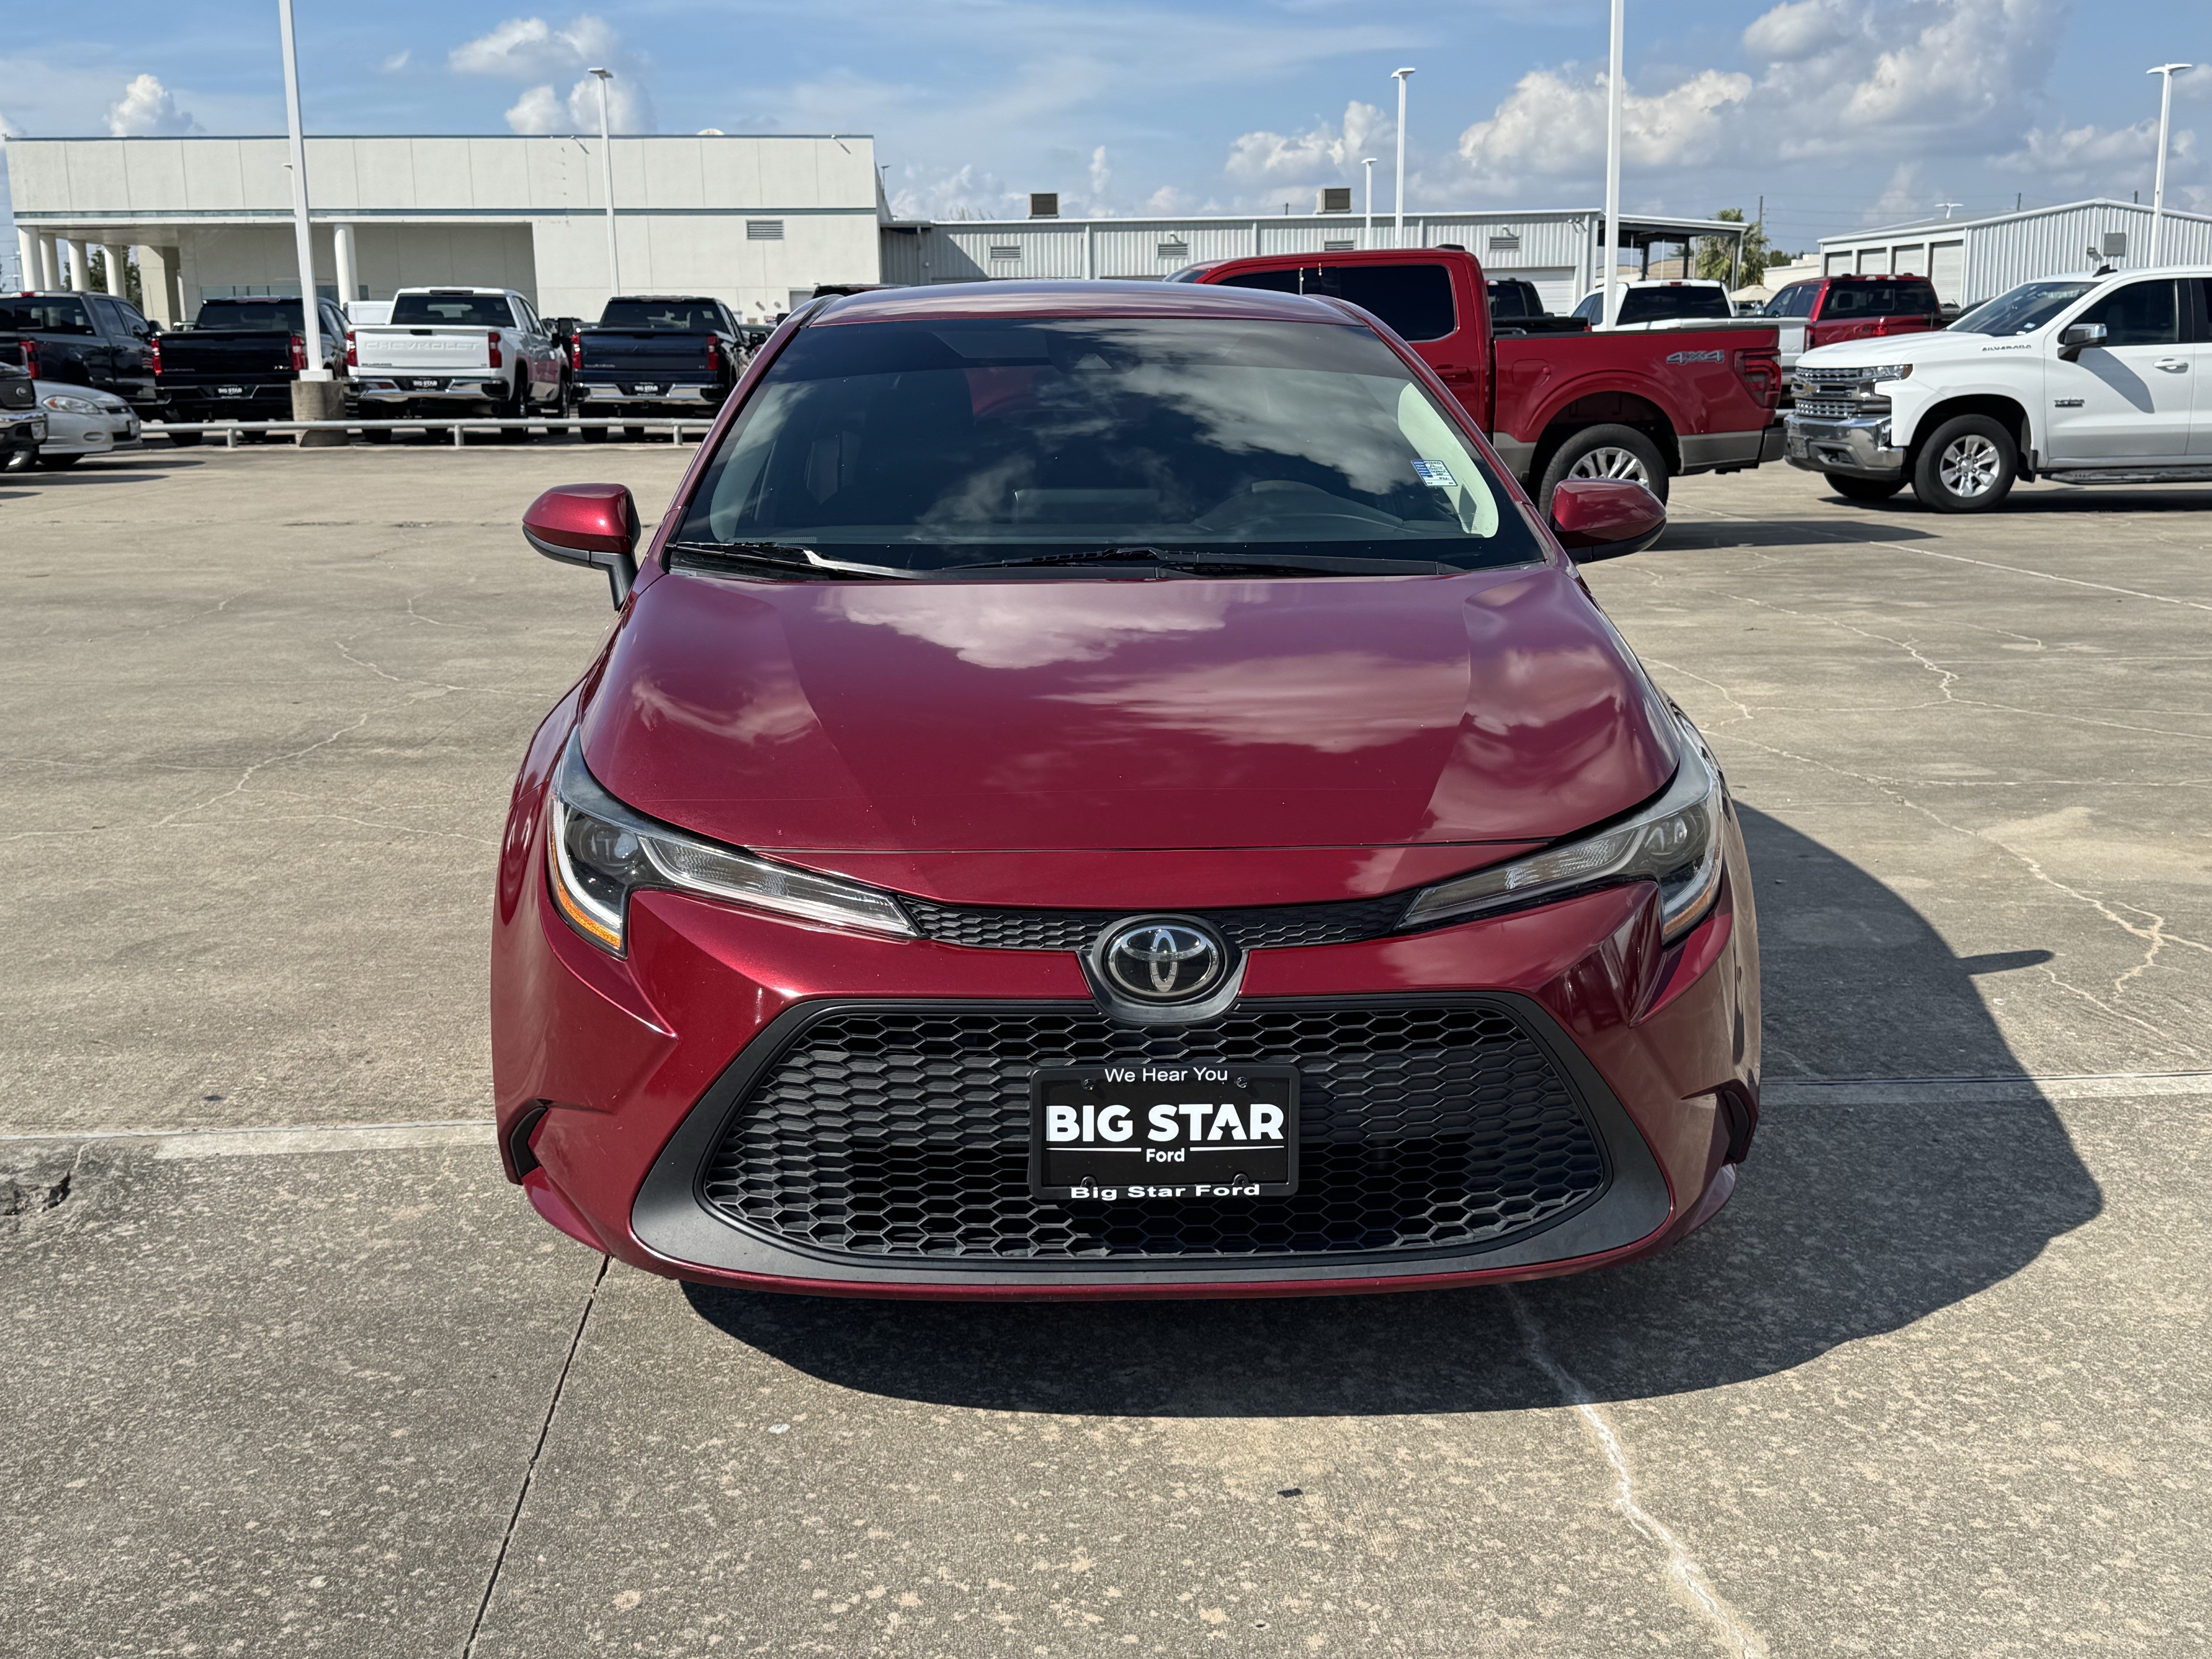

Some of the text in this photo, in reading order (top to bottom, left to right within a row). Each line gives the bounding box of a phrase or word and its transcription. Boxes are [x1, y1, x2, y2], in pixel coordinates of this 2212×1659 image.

[1104, 1067, 1228, 1082] We Hear You
[1046, 1104, 1284, 1142] BIG STAR
[1146, 1148, 1185, 1162] Ford
[1070, 1183, 1260, 1201] Big Star Ford
